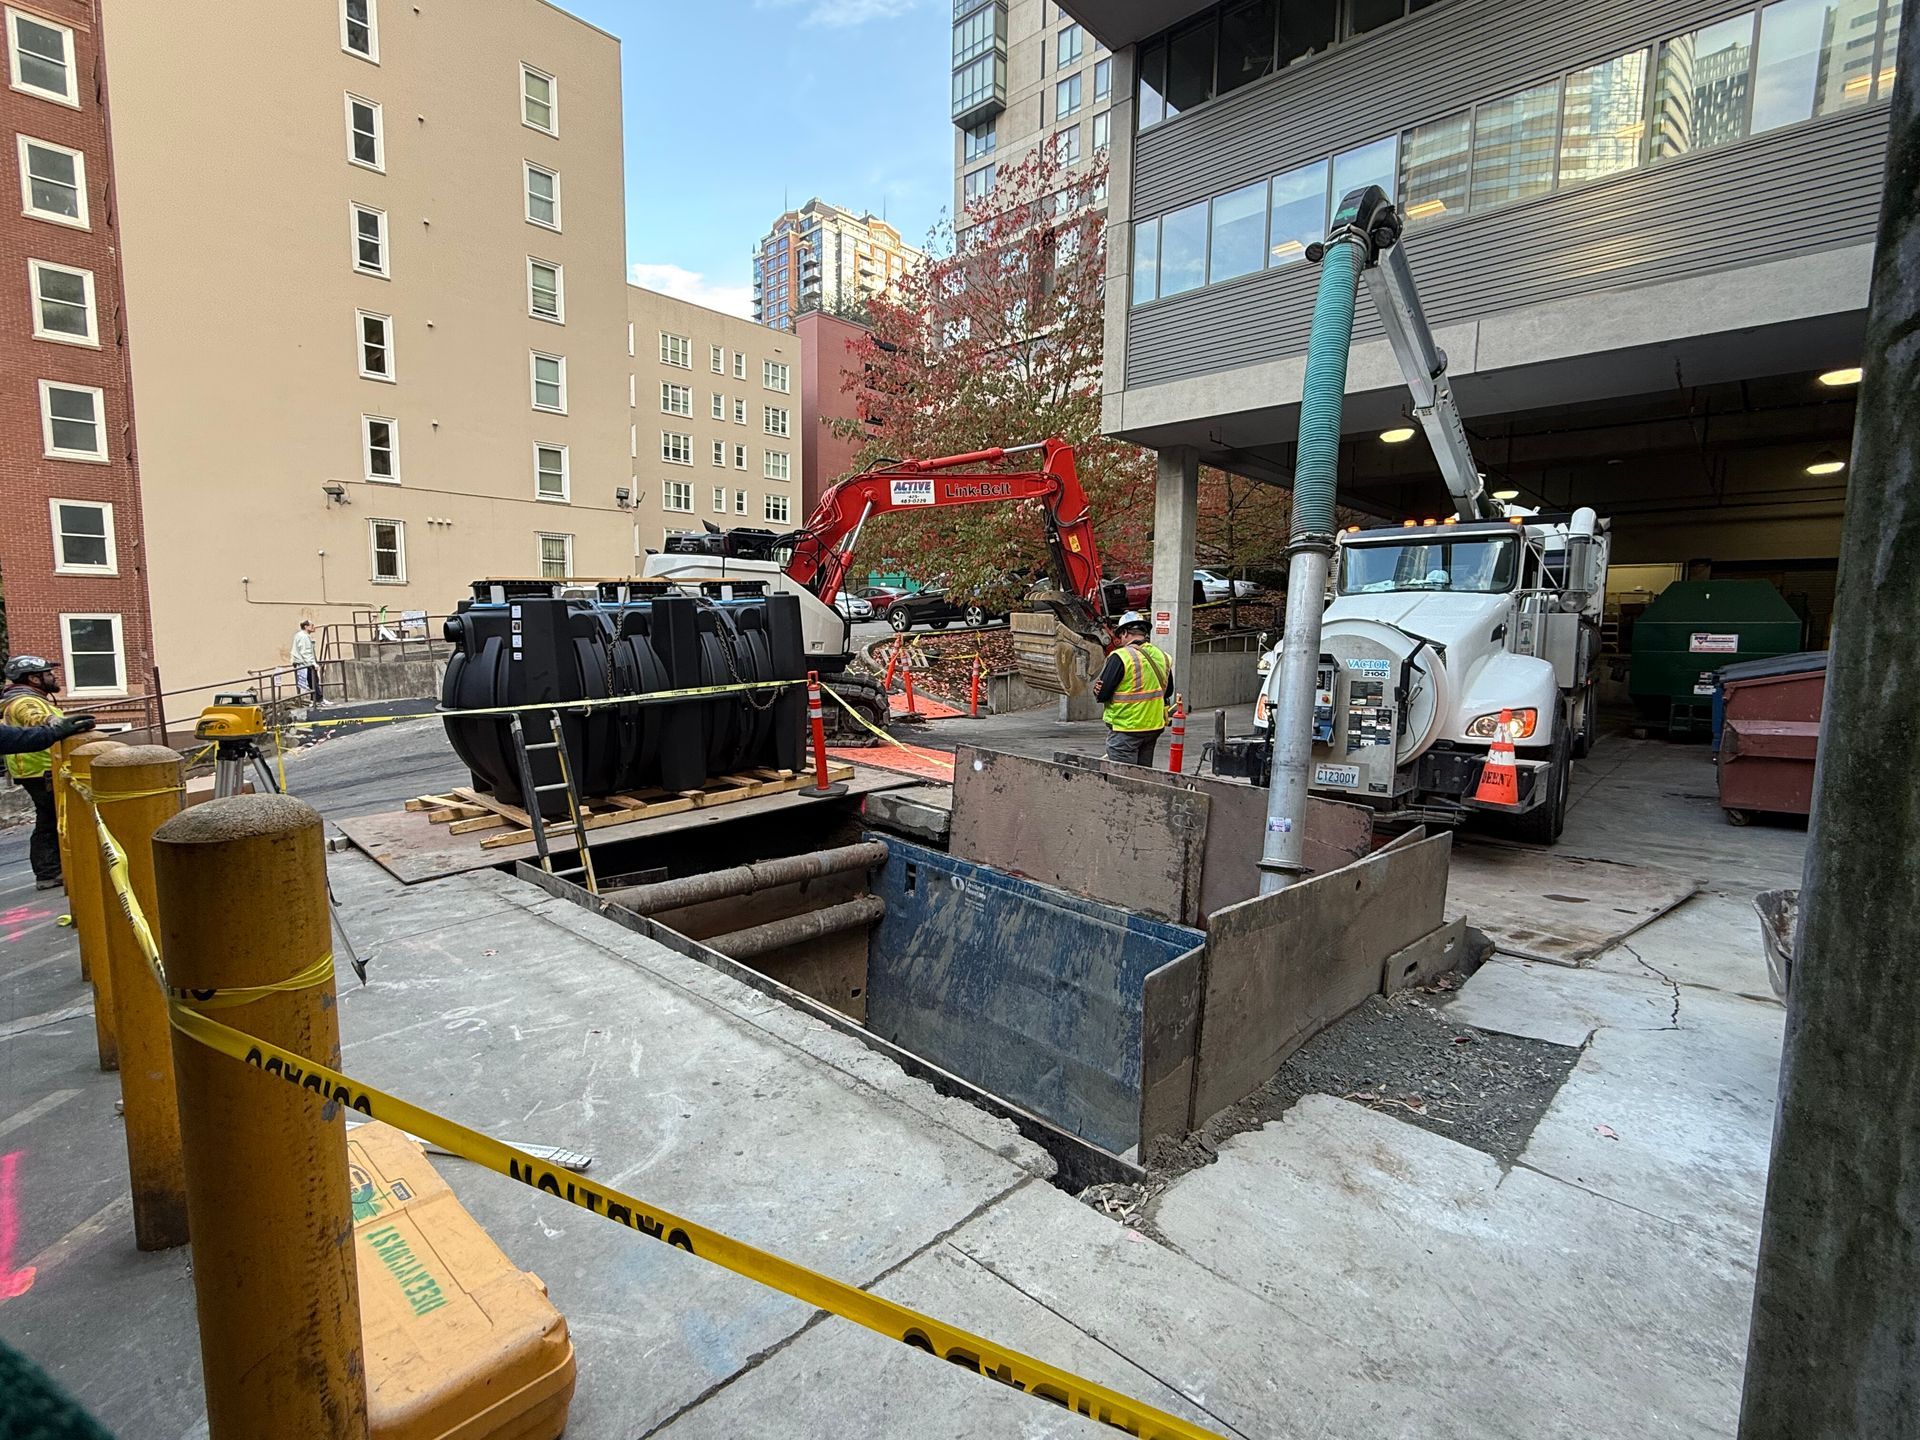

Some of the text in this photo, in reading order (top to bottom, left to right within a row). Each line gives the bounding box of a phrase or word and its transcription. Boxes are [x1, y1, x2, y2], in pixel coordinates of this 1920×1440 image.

[894, 482, 931, 491] ACTIVE
[1347, 659, 1389, 670] VACTOR
[1317, 770, 1357, 785] C12300Y
